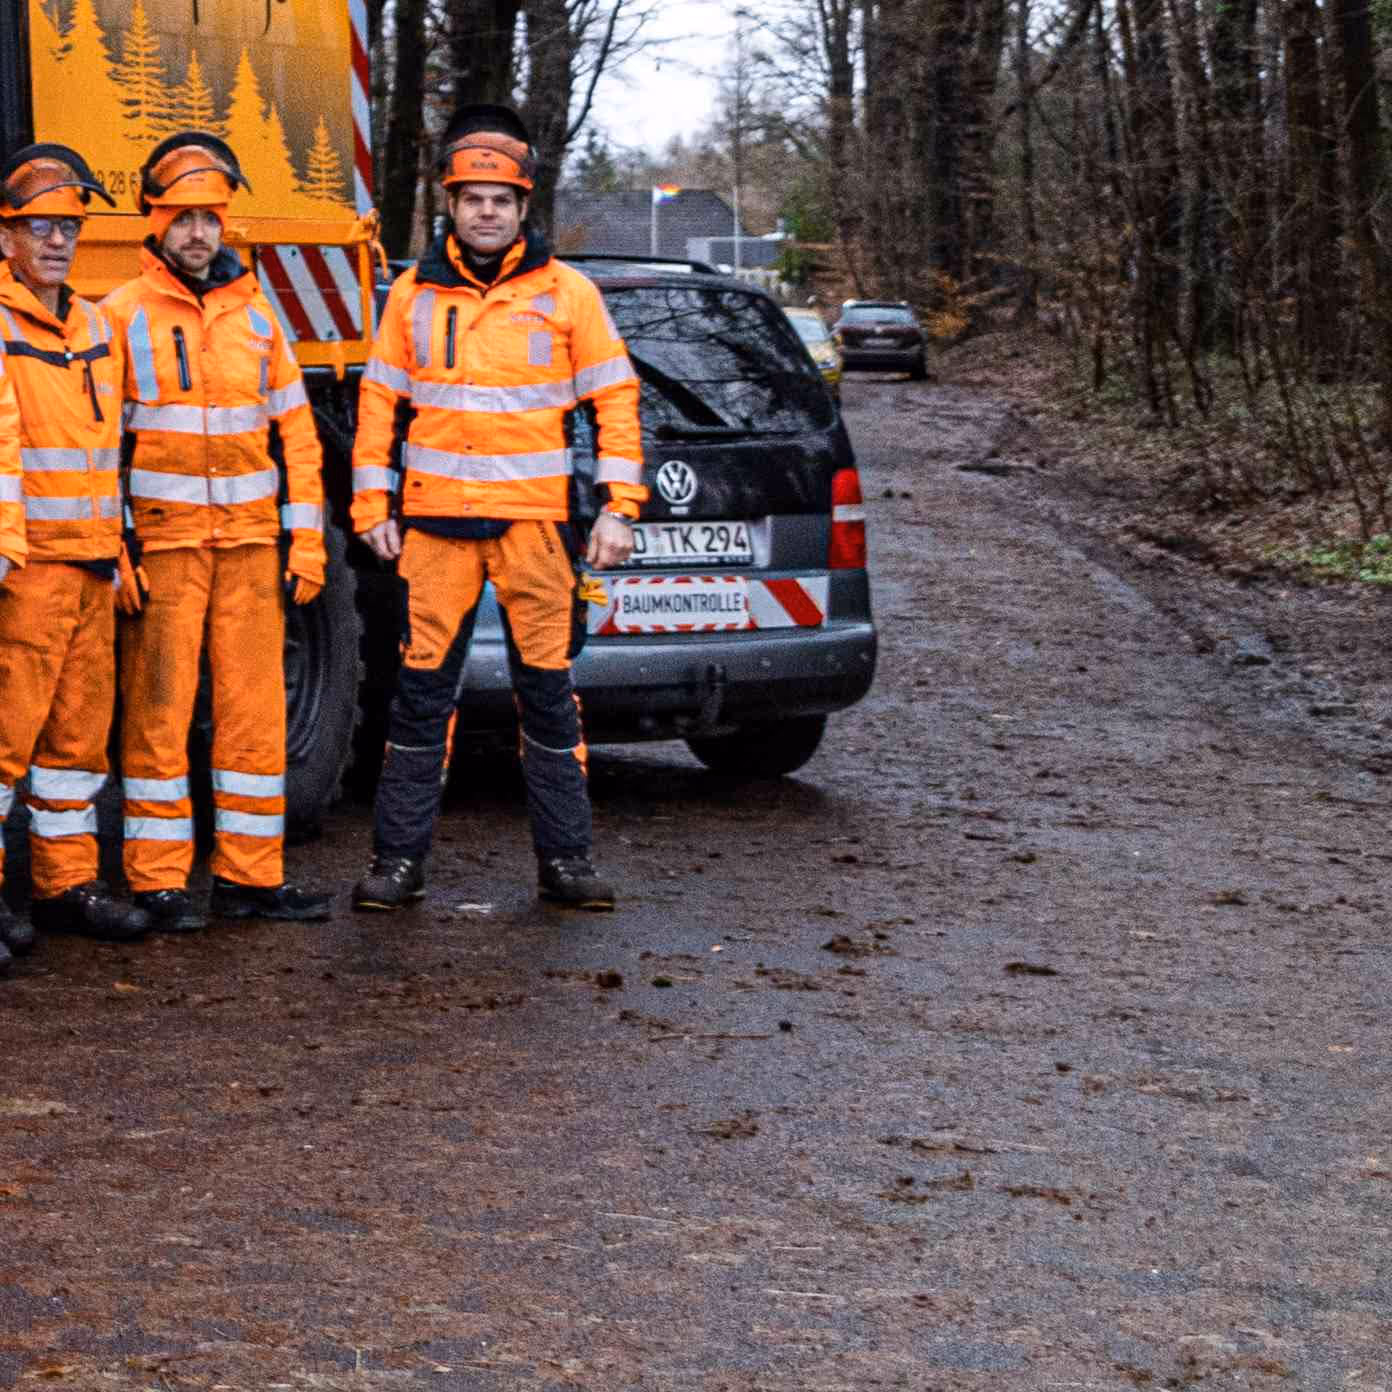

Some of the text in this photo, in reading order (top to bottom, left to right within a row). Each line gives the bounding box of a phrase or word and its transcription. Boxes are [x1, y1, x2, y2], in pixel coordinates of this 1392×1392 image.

[662, 526, 697, 552] TK
[701, 525, 747, 552] 294
[623, 591, 741, 615] BAUMKONTROLLE
